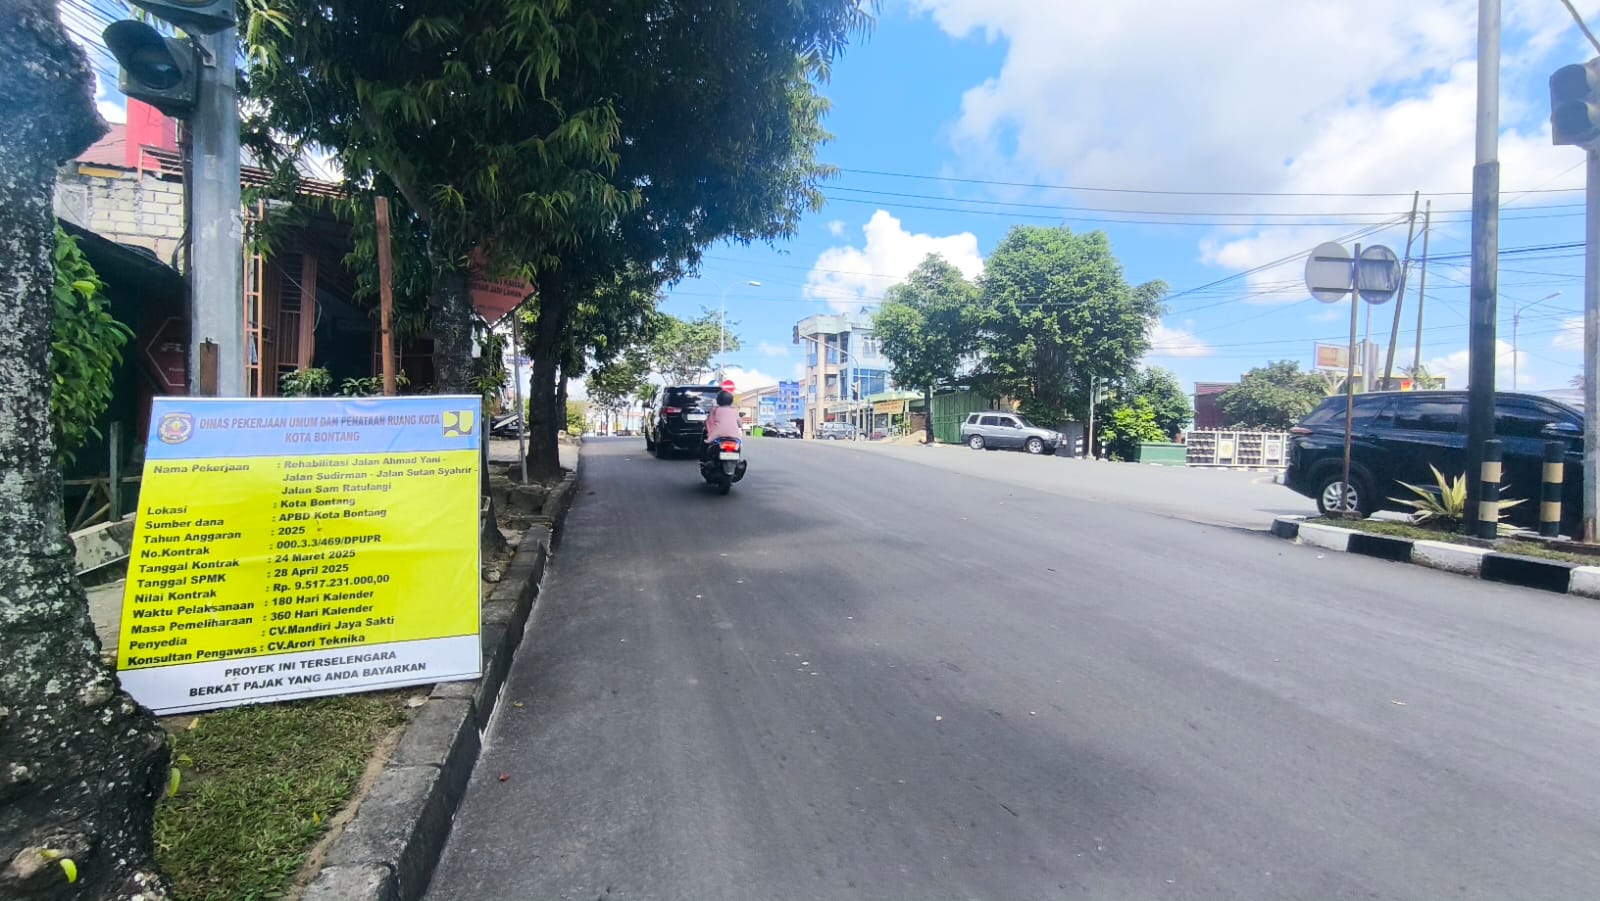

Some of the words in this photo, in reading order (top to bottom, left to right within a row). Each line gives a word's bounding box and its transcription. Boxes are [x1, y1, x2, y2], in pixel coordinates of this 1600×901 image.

[200, 418, 230, 429] DINAS
[231, 418, 286, 428] PEKERJAAN
[289, 416, 318, 428] UMUM
[388, 415, 416, 426] RUANG
[418, 414, 440, 425] KOTA
[285, 432, 312, 443] KOTA
[314, 431, 360, 442] BONTANG
[153, 465, 188, 474] Nama
[192, 464, 250, 473] Pekerjaan
[284, 460, 349, 468] Rehabilitasi
[382, 456, 417, 464] Ahmad
[282, 473, 313, 482] Jalan
[316, 472, 368, 480] Sudirman
[406, 468, 435, 476] Sutan
[281, 486, 312, 494] Jalan
[315, 485, 339, 494] Sam
[343, 482, 392, 492] Ratulangi
[147, 506, 188, 516] Lokasi
[280, 500, 306, 508] Kota
[310, 498, 356, 507] Bontang
[144, 520, 192, 530] Sumber
[194, 518, 224, 527] dana
[278, 512, 310, 522] APBD
[314, 511, 340, 520] Kota
[343, 509, 387, 518] Bontang
[140, 546, 210, 558] No.Kontrak
[276, 534, 382, 549] 000.3.3/469/DPUPR
[144, 534, 180, 544] Tahun
[184, 532, 242, 542] Anggaran
[278, 526, 306, 536] 2025
[140, 562, 188, 574] Tanggal
[192, 559, 240, 570] Kontrak
[274, 554, 289, 563] 24
[292, 552, 325, 562] Maret
[328, 550, 356, 559] 2025
[137, 576, 187, 588] Tanggal
[190, 574, 226, 584] SPMK
[274, 568, 288, 578] 28
[292, 566, 318, 577] April
[322, 564, 350, 574] 2025
[134, 594, 164, 604] Nilai
[168, 589, 217, 600] Kontrak
[272, 584, 290, 592] Rp.
[294, 574, 390, 590] 9.517.231.000,00
[132, 608, 173, 618] Waktu
[177, 602, 255, 616] Pelaksanaan
[272, 596, 293, 606] 180
[296, 594, 320, 604] Hari
[323, 590, 374, 602] Kalender
[130, 624, 166, 634] Masa
[169, 617, 253, 631] Pemeliharaan
[270, 610, 292, 621] 360
[294, 608, 319, 618] Hari
[322, 604, 374, 616] Kalender
[129, 637, 188, 650] Penyedia
[268, 622, 331, 636] CV.Mandiri
[334, 620, 362, 630] Jaya
[365, 616, 394, 626] Sakti
[127, 653, 192, 666] Konsultan
[196, 646, 258, 659] Pengawas
[268, 639, 316, 652] CV.Arori
[320, 634, 366, 646] Teknika
[224, 664, 276, 677] PROYEK
[278, 662, 296, 672] INI
[300, 650, 397, 670] TERSELENGARA
[189, 682, 240, 696] BERKAT
[244, 678, 284, 690] PAJAK
[288, 674, 320, 685] YANG
[324, 670, 359, 682] ANDA
[362, 662, 427, 678] BAYARKAN
